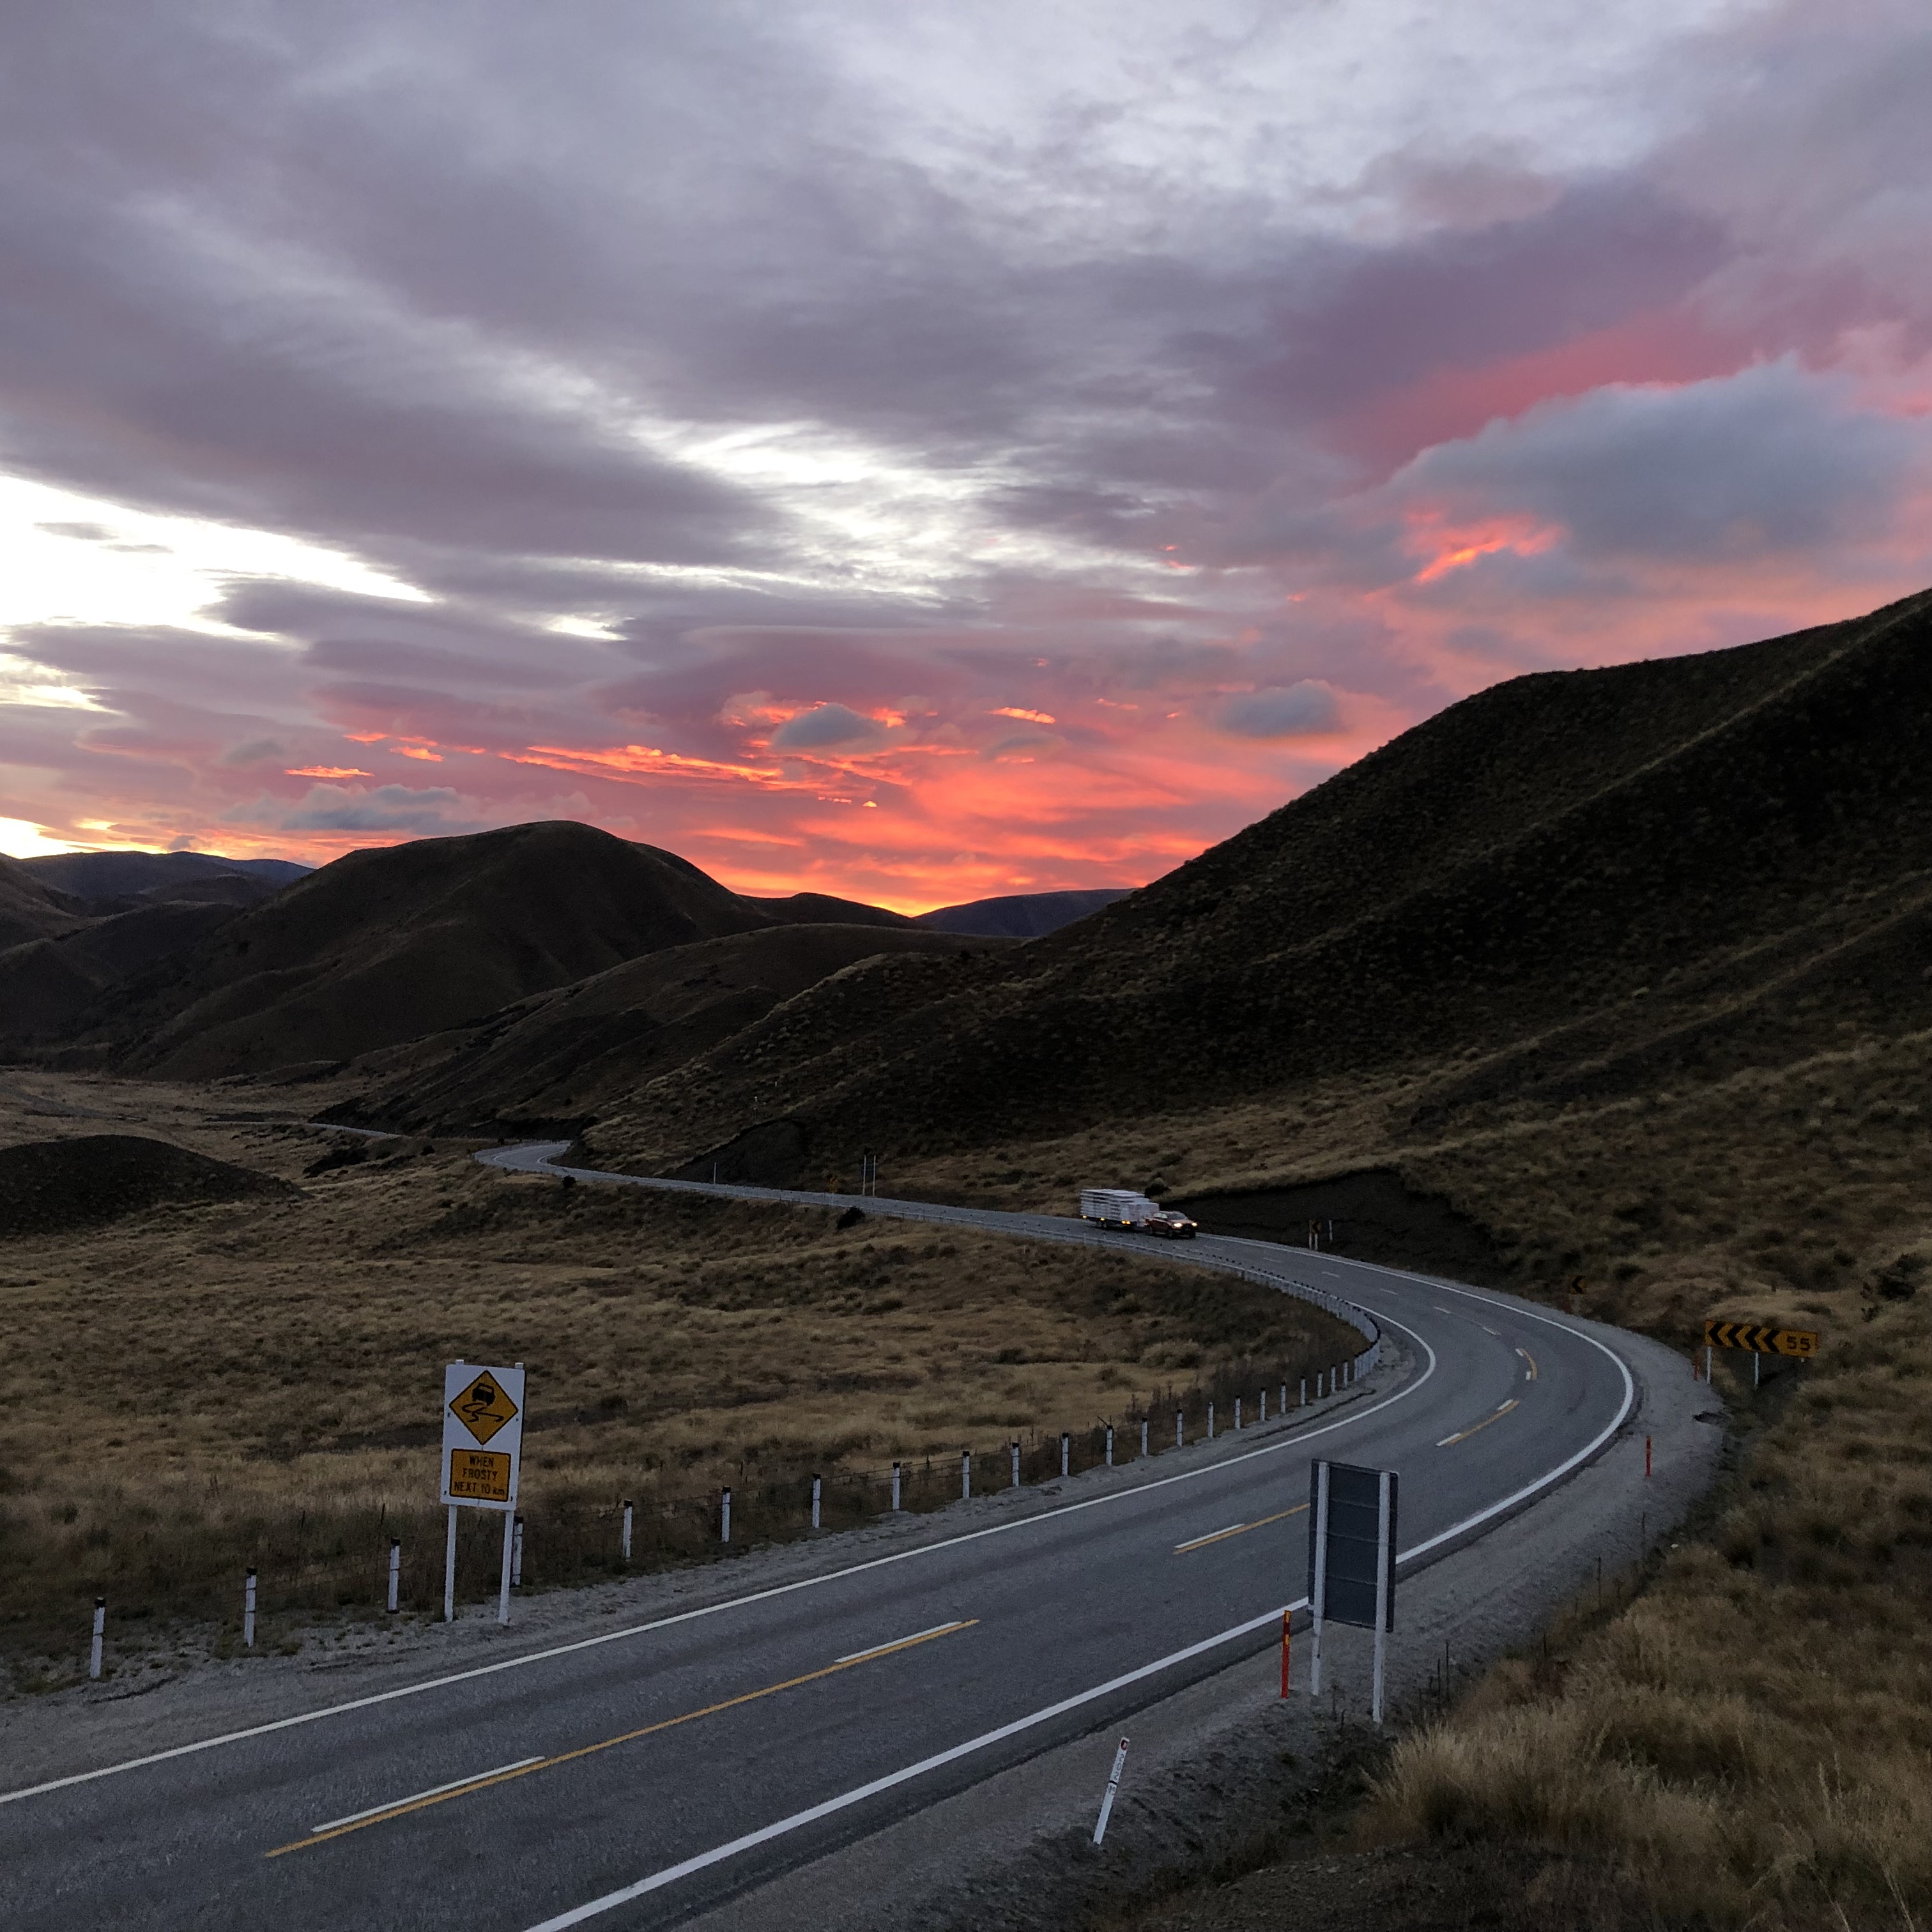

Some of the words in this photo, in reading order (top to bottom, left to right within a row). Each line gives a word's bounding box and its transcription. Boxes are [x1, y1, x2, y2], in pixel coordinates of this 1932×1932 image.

[1786, 1335, 1811, 1351] 55
[468, 1455, 494, 1468] WHEN
[462, 1468, 498, 1482] FROSTY
[454, 1481, 477, 1493] NEXT
[480, 1483, 491, 1494] 10
[493, 1487, 505, 1496] km
